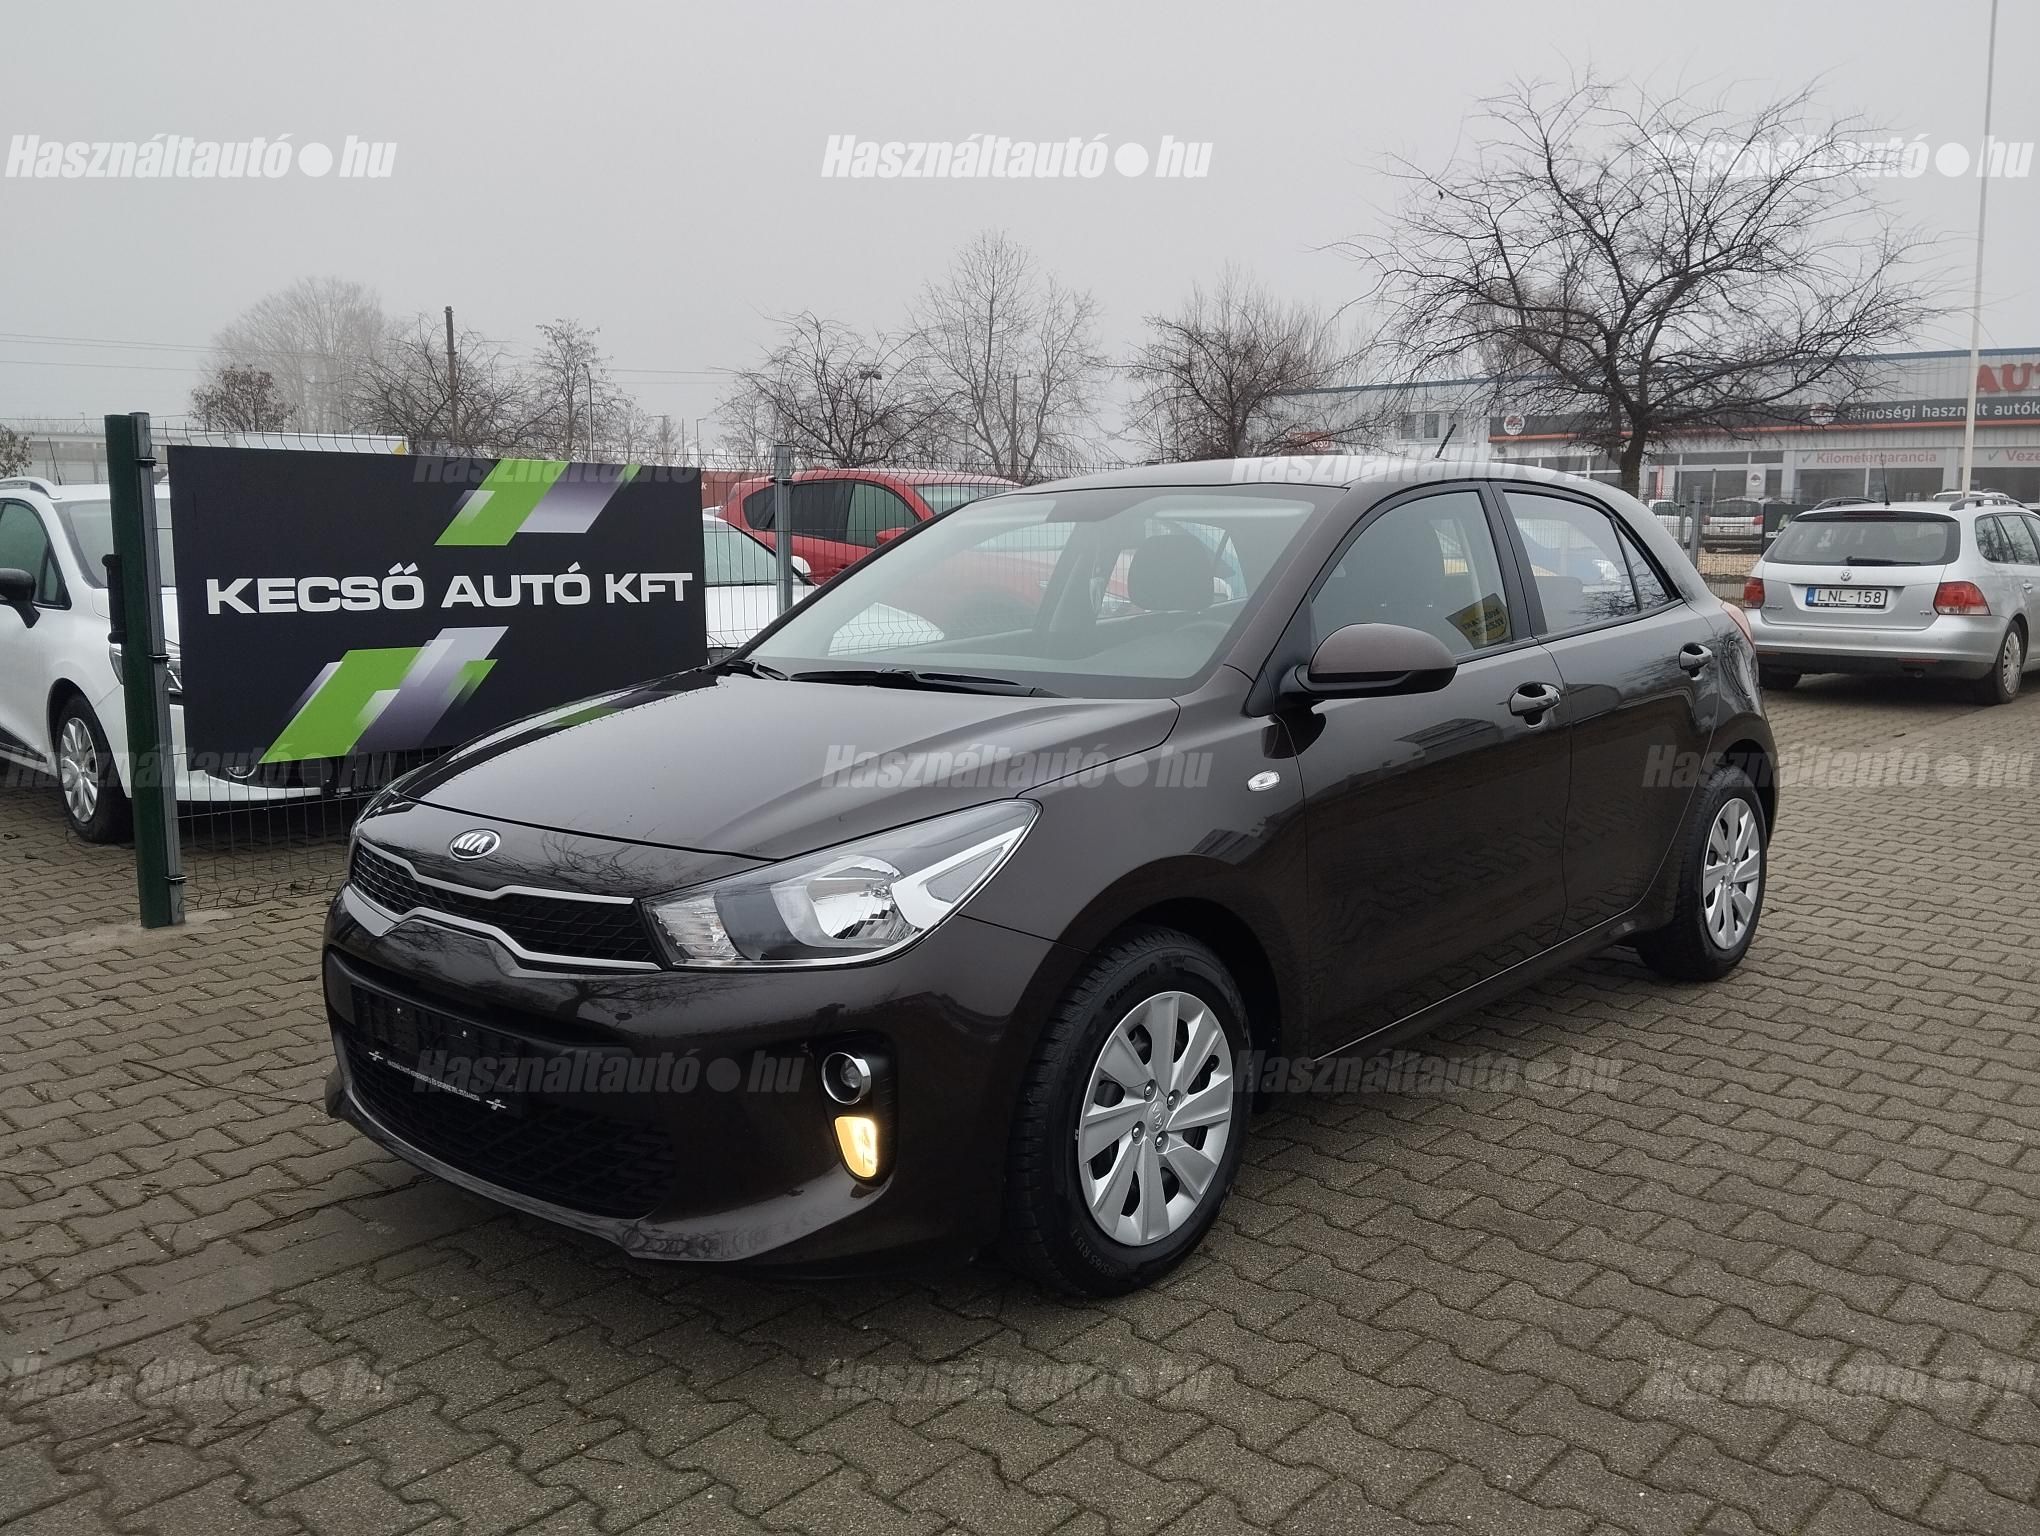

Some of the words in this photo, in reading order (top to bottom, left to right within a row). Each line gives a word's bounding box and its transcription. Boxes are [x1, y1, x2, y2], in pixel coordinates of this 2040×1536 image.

[1976, 362, 2040, 392] AU
[1922, 402, 1988, 418] hasznlt
[1994, 401, 2040, 416] autók
[1816, 450, 1937, 465] Kilométergarancia
[206, 561, 426, 615] KECSŐ
[440, 561, 592, 608] AUTÓ
[605, 572, 693, 604] KFT
[1817, 590, 1882, 604] LNL-158
[452, 832, 492, 854] KIA
